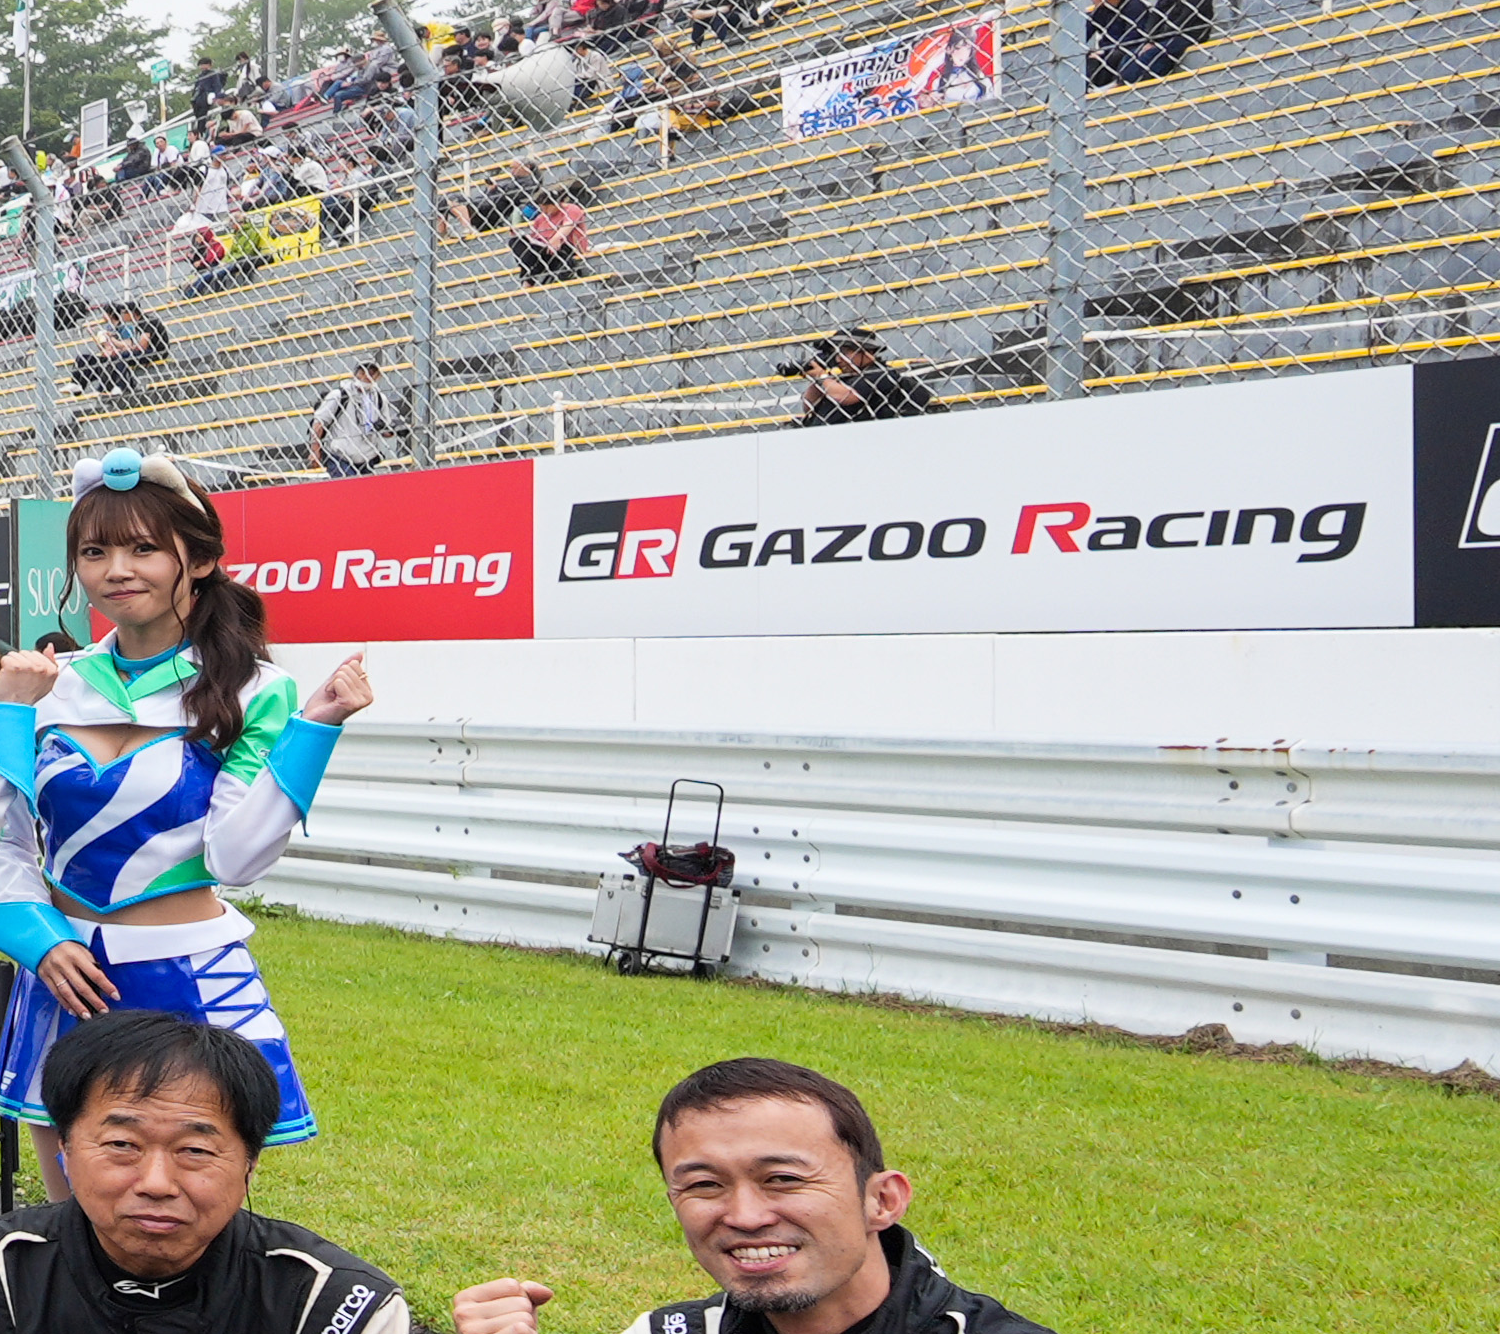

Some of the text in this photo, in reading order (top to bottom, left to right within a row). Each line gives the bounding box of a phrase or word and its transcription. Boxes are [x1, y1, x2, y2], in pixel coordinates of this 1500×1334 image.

[332, 544, 512, 599] Racing
[562, 501, 1368, 580] GR GAZOO Racing
